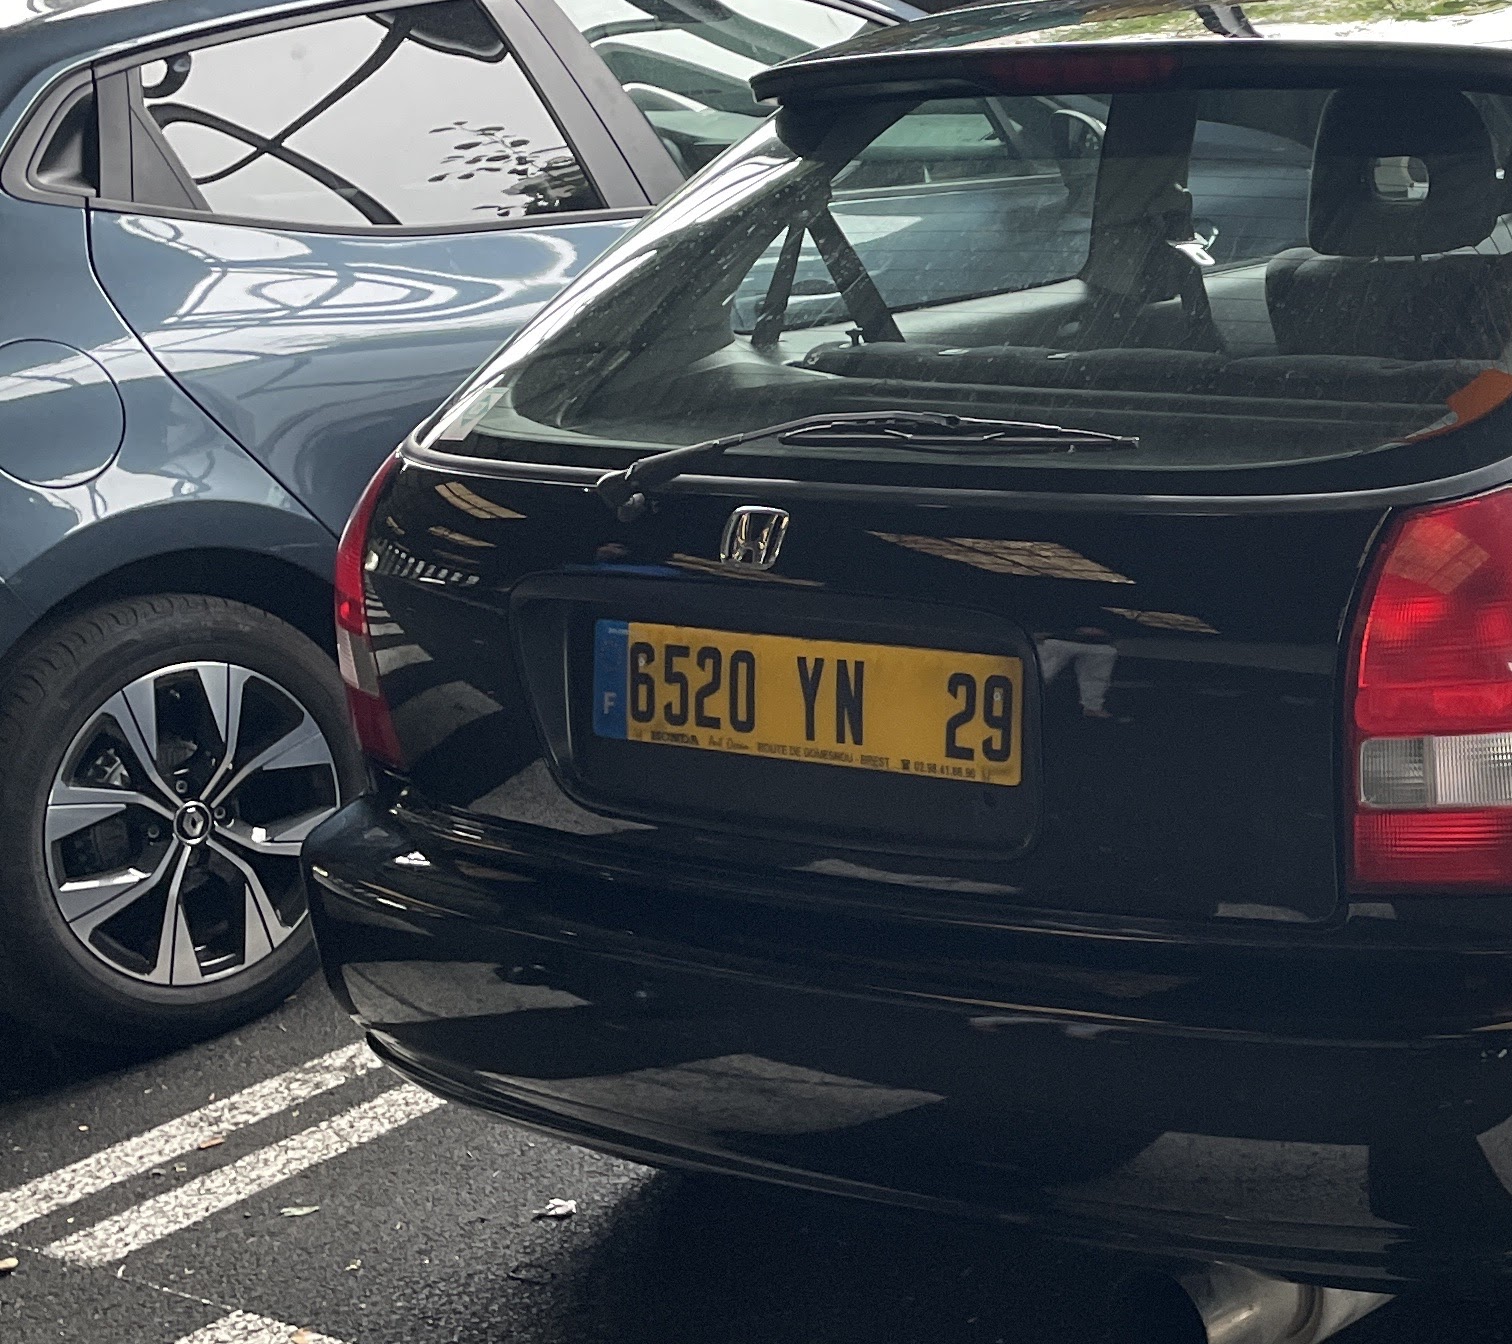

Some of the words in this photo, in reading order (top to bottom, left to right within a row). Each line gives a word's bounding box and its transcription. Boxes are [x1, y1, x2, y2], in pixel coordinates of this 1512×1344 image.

[603, 691, 618, 715] F
[629, 642, 755, 734] 6520
[798, 657, 865, 747] YN
[945, 672, 1014, 762] 29
